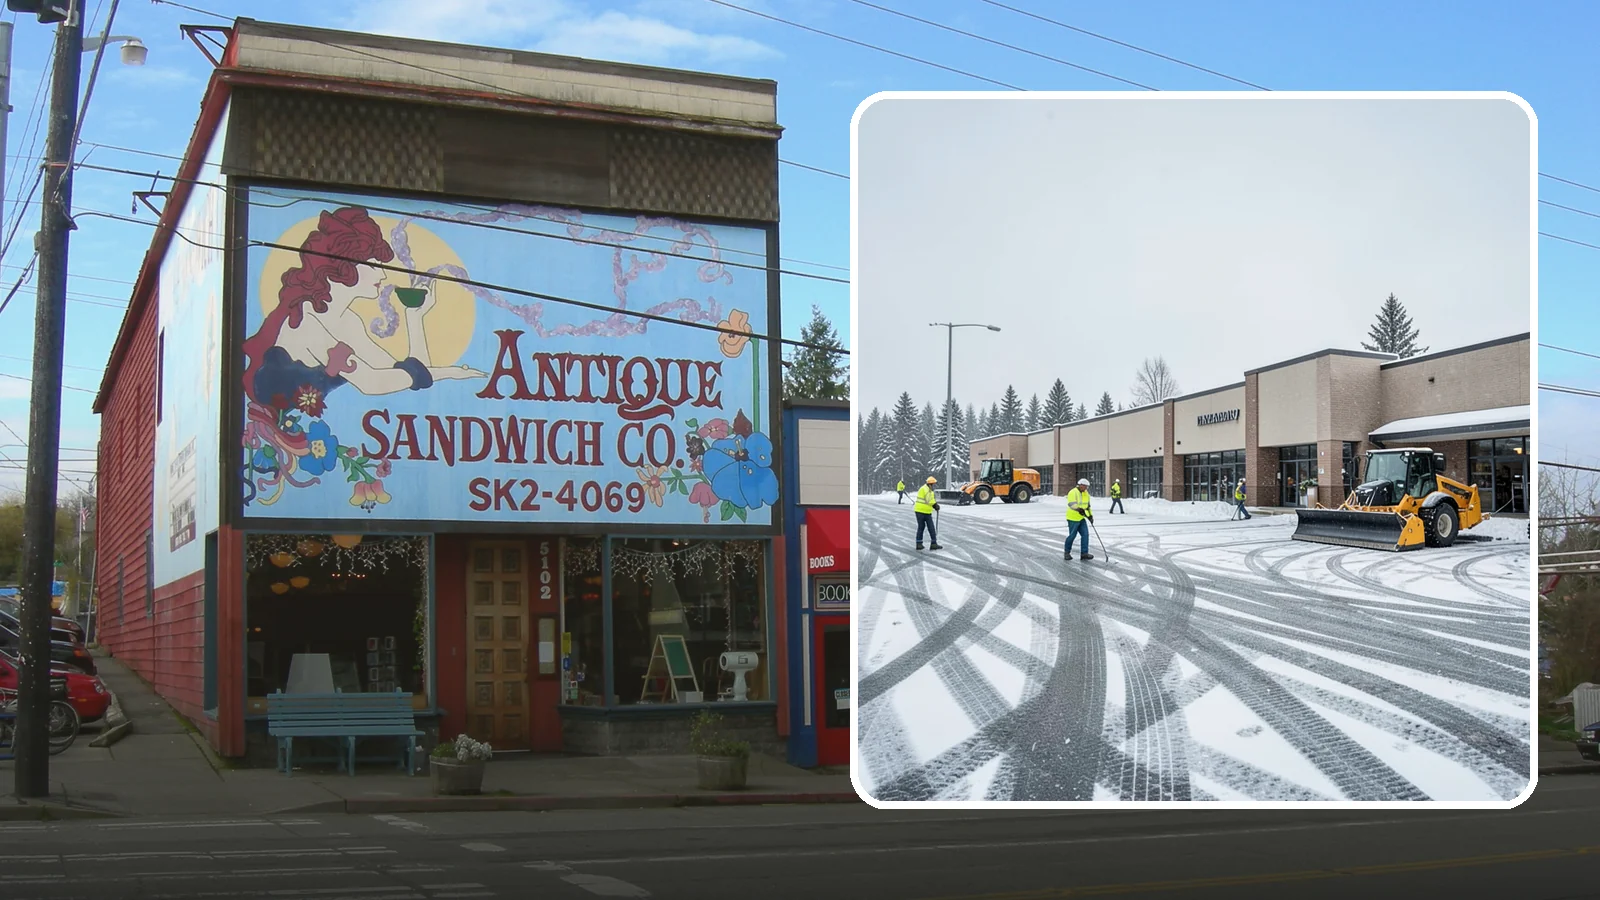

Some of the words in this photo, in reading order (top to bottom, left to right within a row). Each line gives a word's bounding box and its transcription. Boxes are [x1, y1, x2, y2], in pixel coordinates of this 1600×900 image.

[475, 329, 724, 421] ANTIQUE
[361, 409, 605, 466] SANDWICH
[617, 422, 686, 469] CO.
[468, 478, 646, 513] SK2-4069
[539, 541, 552, 600] 5102
[809, 555, 835, 569] BOOKS
